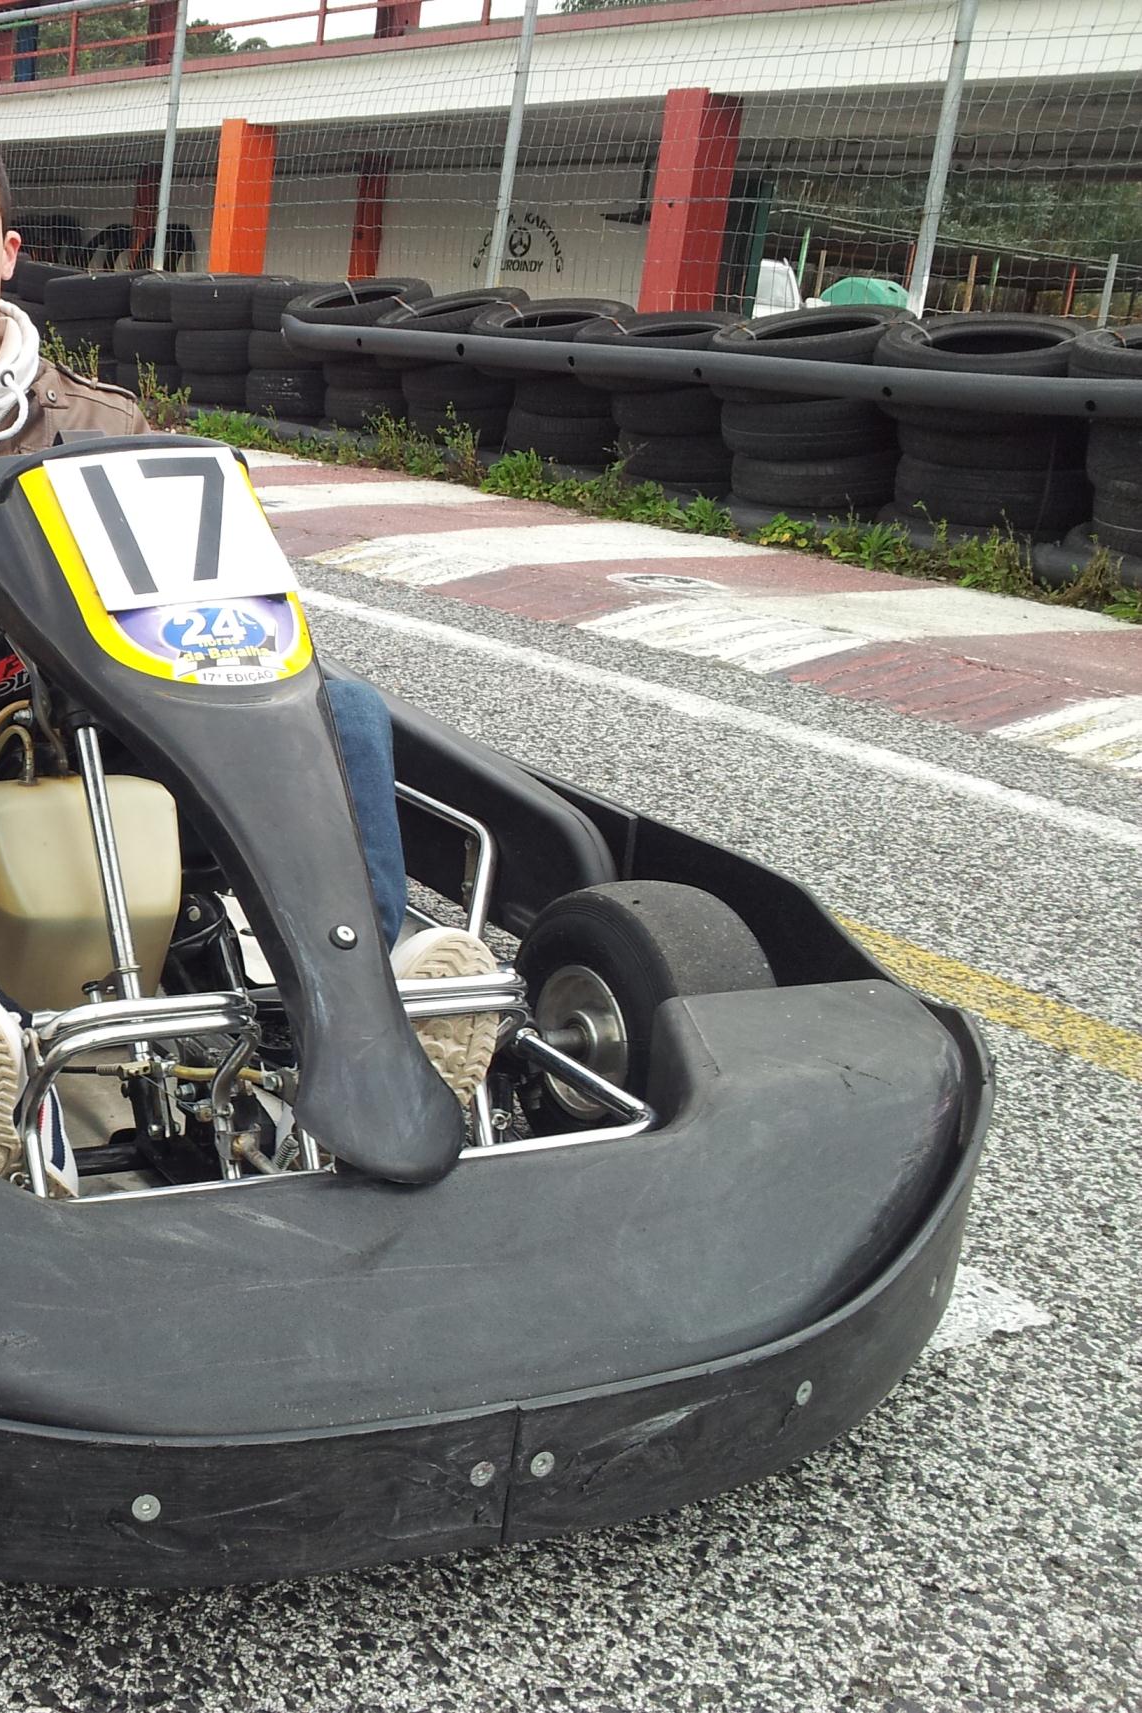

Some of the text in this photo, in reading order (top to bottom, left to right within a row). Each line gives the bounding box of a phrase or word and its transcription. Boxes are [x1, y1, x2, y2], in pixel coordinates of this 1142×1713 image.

[523, 211, 564, 273] KARTING
[79, 456, 225, 595] 17
[172, 606, 248, 646] 24
[207, 645, 270, 660] Batalha
